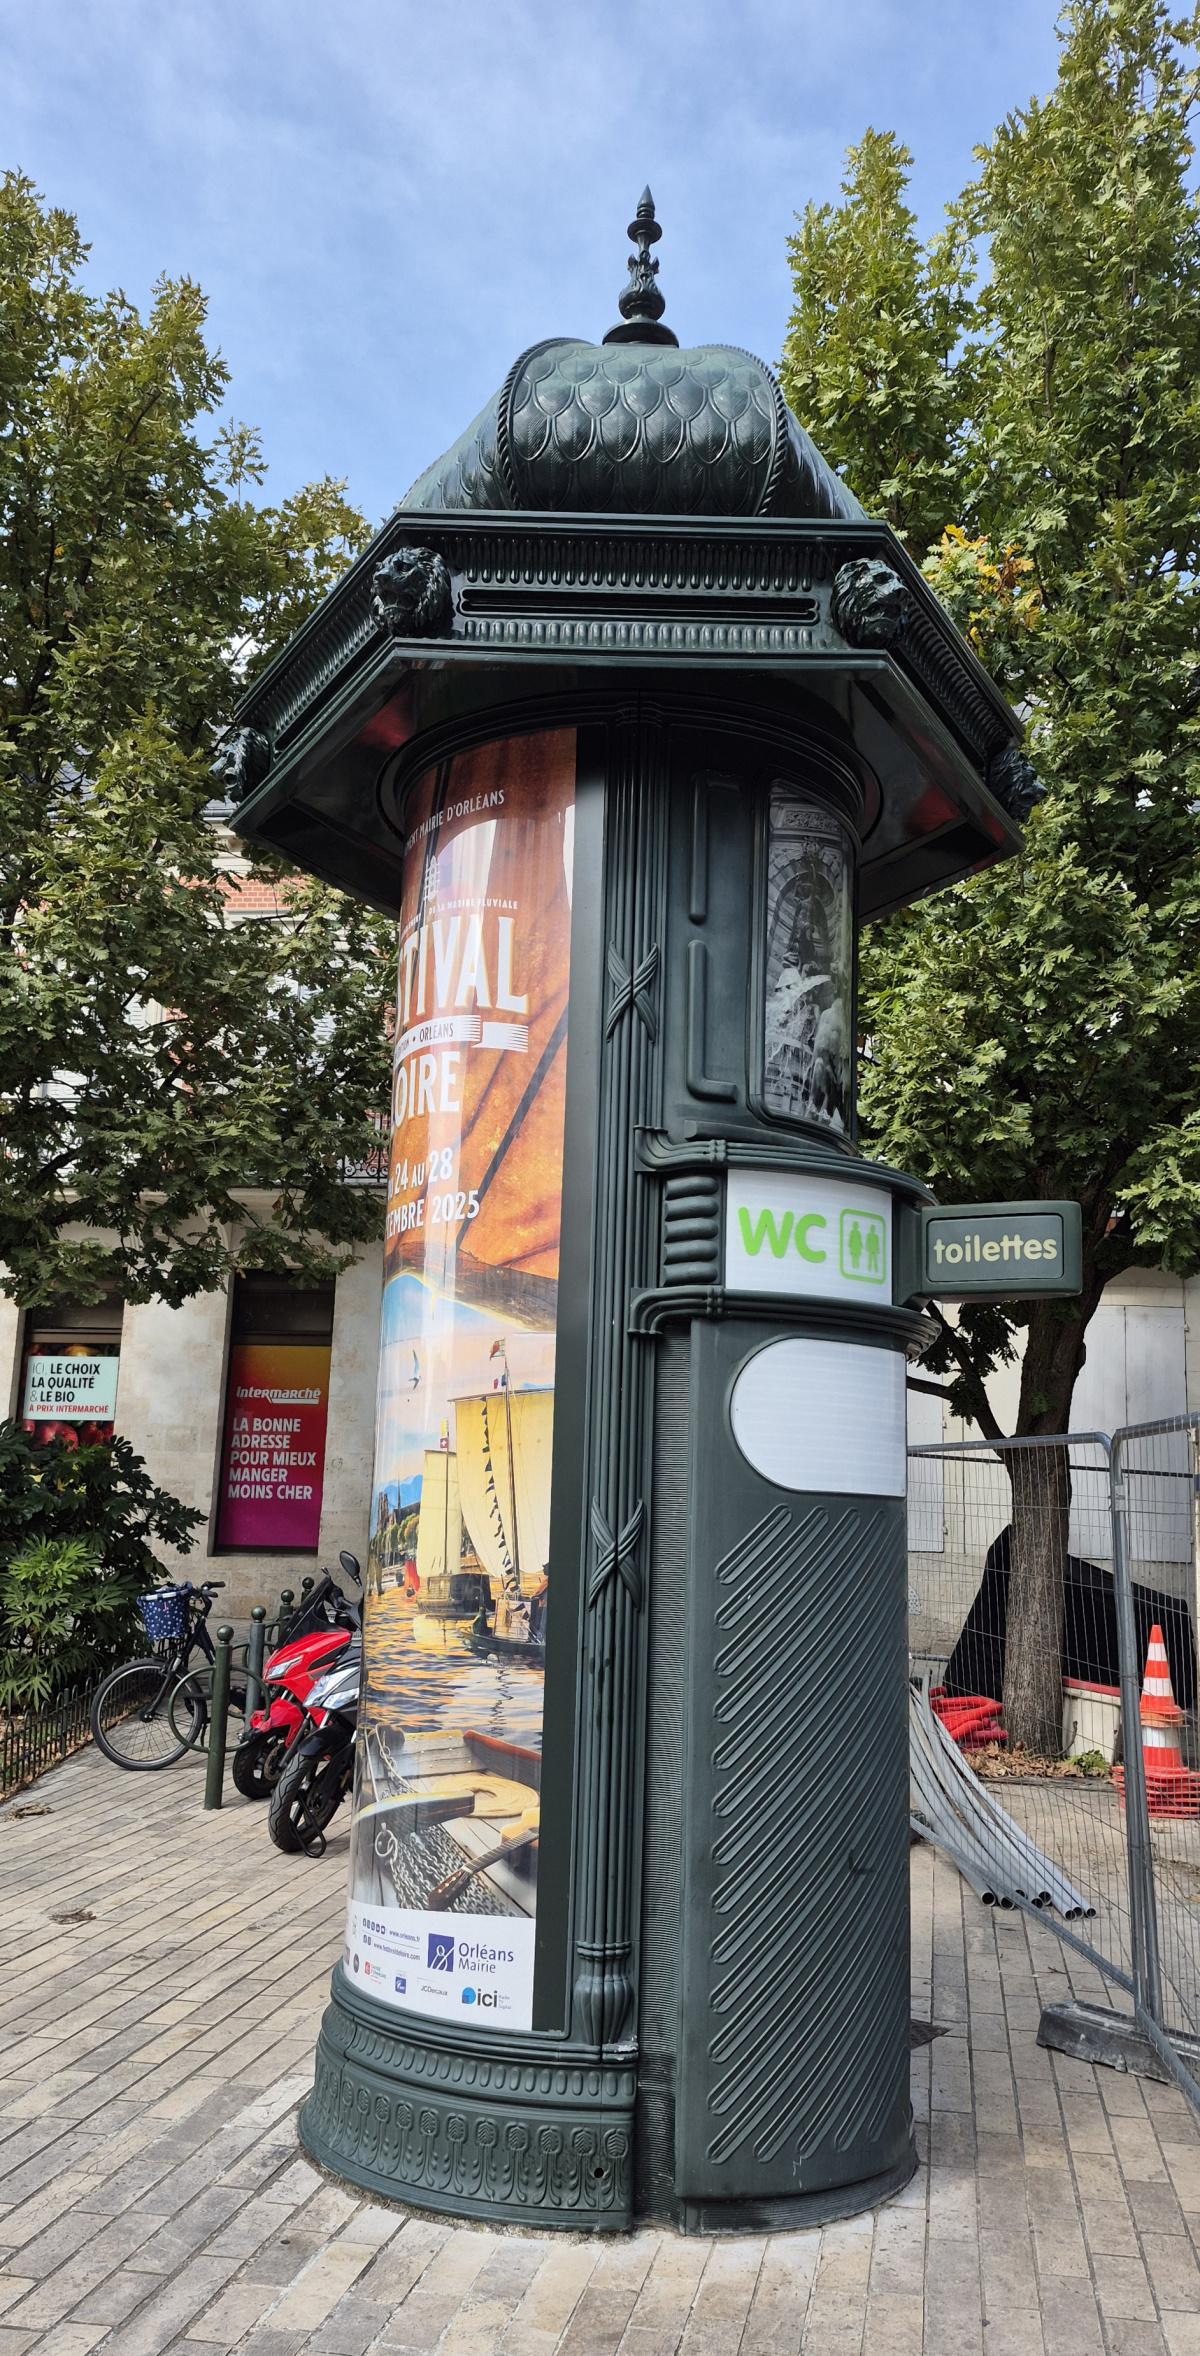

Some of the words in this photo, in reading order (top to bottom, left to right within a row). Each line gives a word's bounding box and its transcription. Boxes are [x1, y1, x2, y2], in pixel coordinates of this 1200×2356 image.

[420, 811, 444, 838] MAIRIE
[447, 790, 505, 822] D'ORLÉANS
[398, 914, 528, 1025] TIVAL
[394, 1158, 408, 1195] 24
[411, 1162, 425, 1188] AU
[428, 1147, 453, 1184] 28
[431, 1190, 480, 1224] 2025
[737, 1206, 827, 1263] WC
[933, 1233, 1058, 1265] toilettes
[50, 1363, 63, 1375] LE
[65, 1363, 100, 1375] CHOIX
[31, 1377, 45, 1388] LA
[47, 1375, 95, 1389] QUALITÉ
[40, 1391, 52, 1402] LE
[55, 1391, 75, 1402] BIO
[36, 1404, 54, 1412] PRIX
[56, 1404, 109, 1413] INTERMARCHÉ
[233, 1417, 249, 1431] LA
[252, 1418, 301, 1432] BONNE
[231, 1434, 291, 1448] ADRESSE
[230, 1451, 269, 1465] POUR
[272, 1451, 317, 1466] MIEUX
[229, 1467, 288, 1482] MANGER
[228, 1484, 273, 1499] MOINS
[276, 1485, 313, 1500] CHER
[458, 1942, 514, 1962] Orléans
[458, 1957, 496, 1974] Mairie
[477, 1988, 498, 2008] ici
